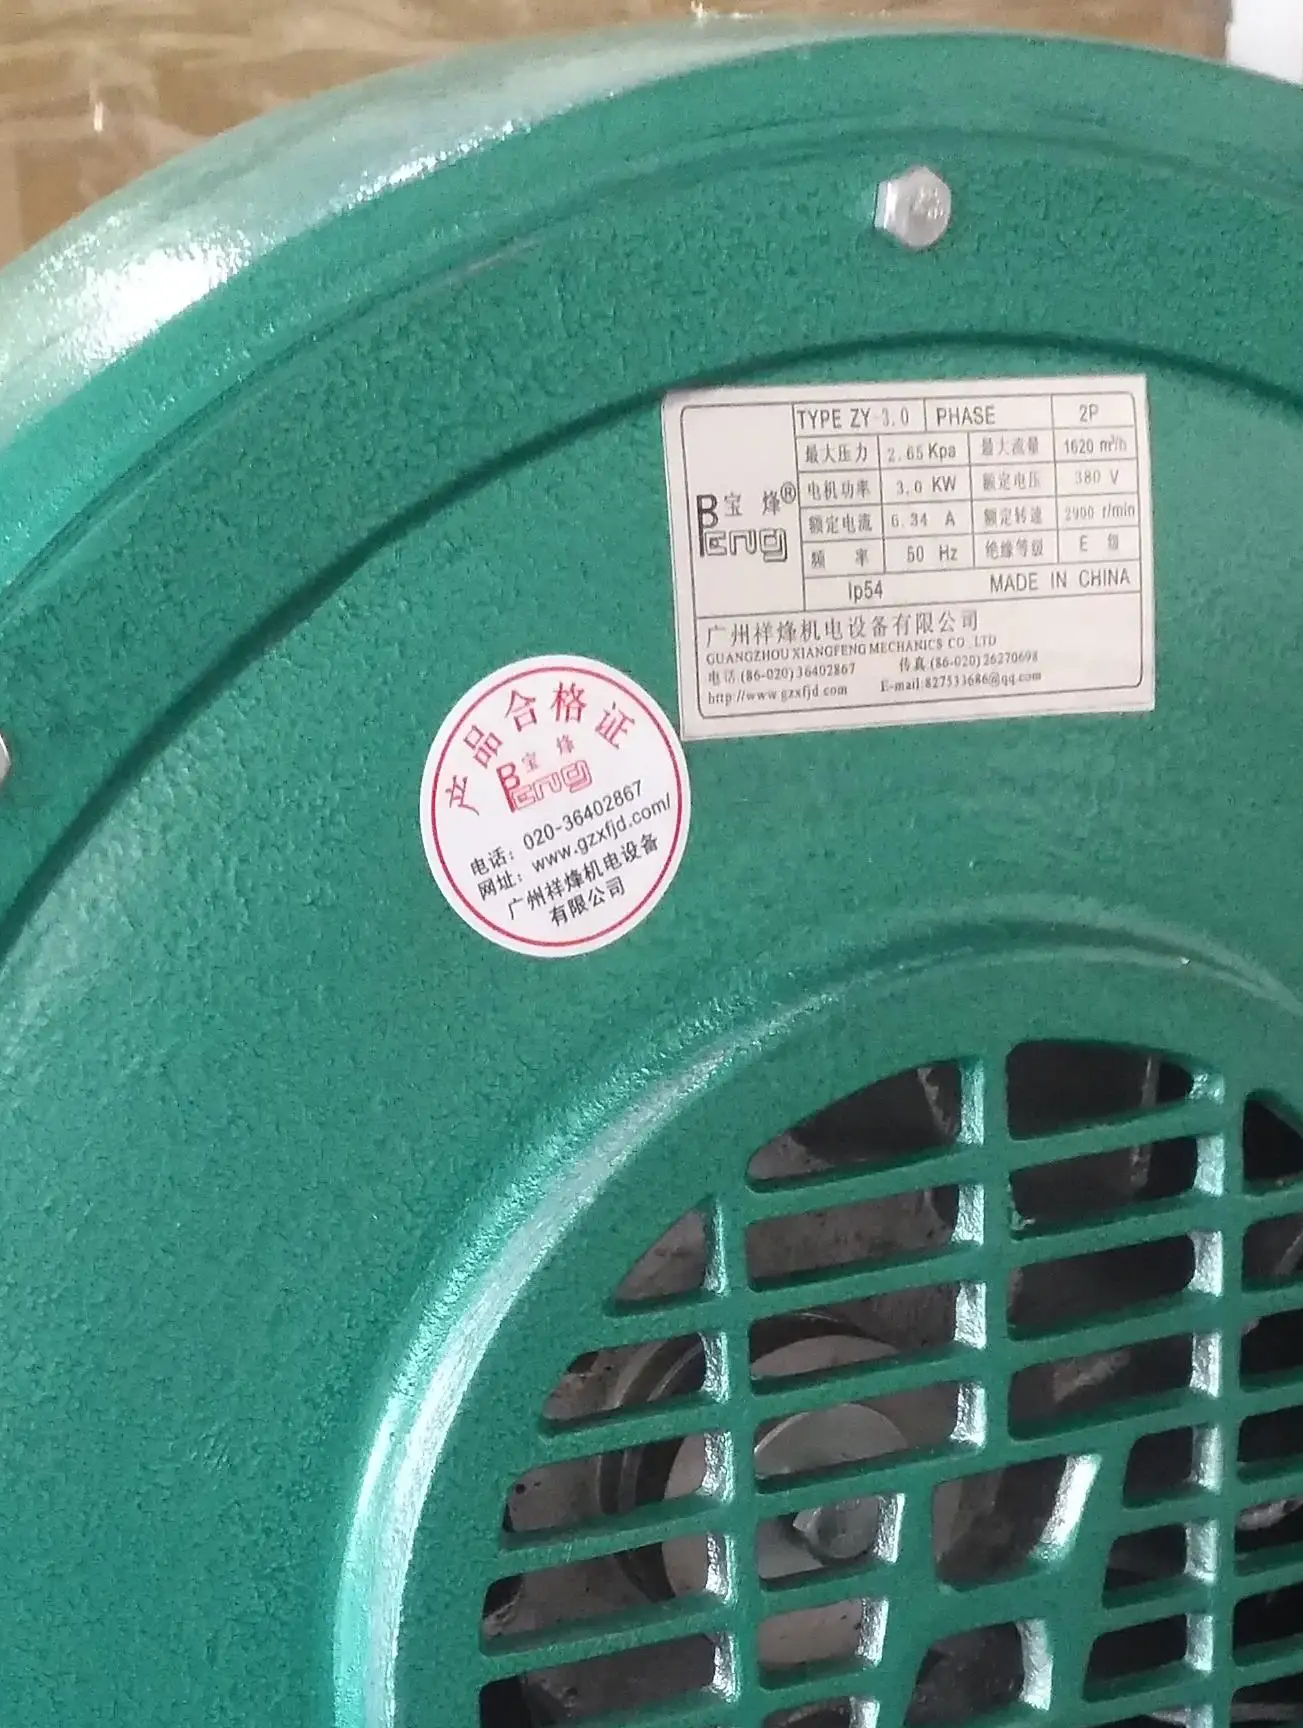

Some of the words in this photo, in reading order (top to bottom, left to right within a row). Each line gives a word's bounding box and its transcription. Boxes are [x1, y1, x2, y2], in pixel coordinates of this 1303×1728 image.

[797, 409, 842, 429] TYPE
[936, 405, 995, 426] PHASE
[1079, 404, 1098, 422] 2P
[805, 442, 868, 464] 最大压力
[982, 436, 1039, 456] 最大流量
[897, 480, 923, 495] 3.0
[932, 476, 956, 492] KW
[983, 472, 1041, 491] 额定电压
[1075, 470, 1100, 484] 380
[1110, 470, 1119, 484] V
[807, 480, 870, 500] 电机功率
[945, 510, 955, 526] A
[984, 505, 1042, 527] 额定转速
[1102, 502, 1135, 518] r/min
[809, 513, 872, 534] 额定电流
[907, 546, 924, 563] 50
[939, 544, 957, 561] Hz
[985, 538, 1043, 559] 绝缘等级
[1080, 535, 1088, 551] E
[990, 573, 1038, 593] MADE
[1051, 570, 1067, 589] IN
[1079, 568, 1130, 588] CHINA
[707, 610, 979, 648] 广州祥烽机电设备有限公司
[706, 649, 789, 665] GUANGZHOU
[792, 643, 866, 660] XIANGFENG
[869, 638, 943, 654] MECHANICS
[445, 681, 636, 816] 产品合格证
[523, 779, 642, 851] 020-36402867
[532, 792, 671, 873] www.gzxfjd.com/
[508, 832, 659, 920] 广州祥烽机电设备
[550, 875, 626, 927] 有限公司
